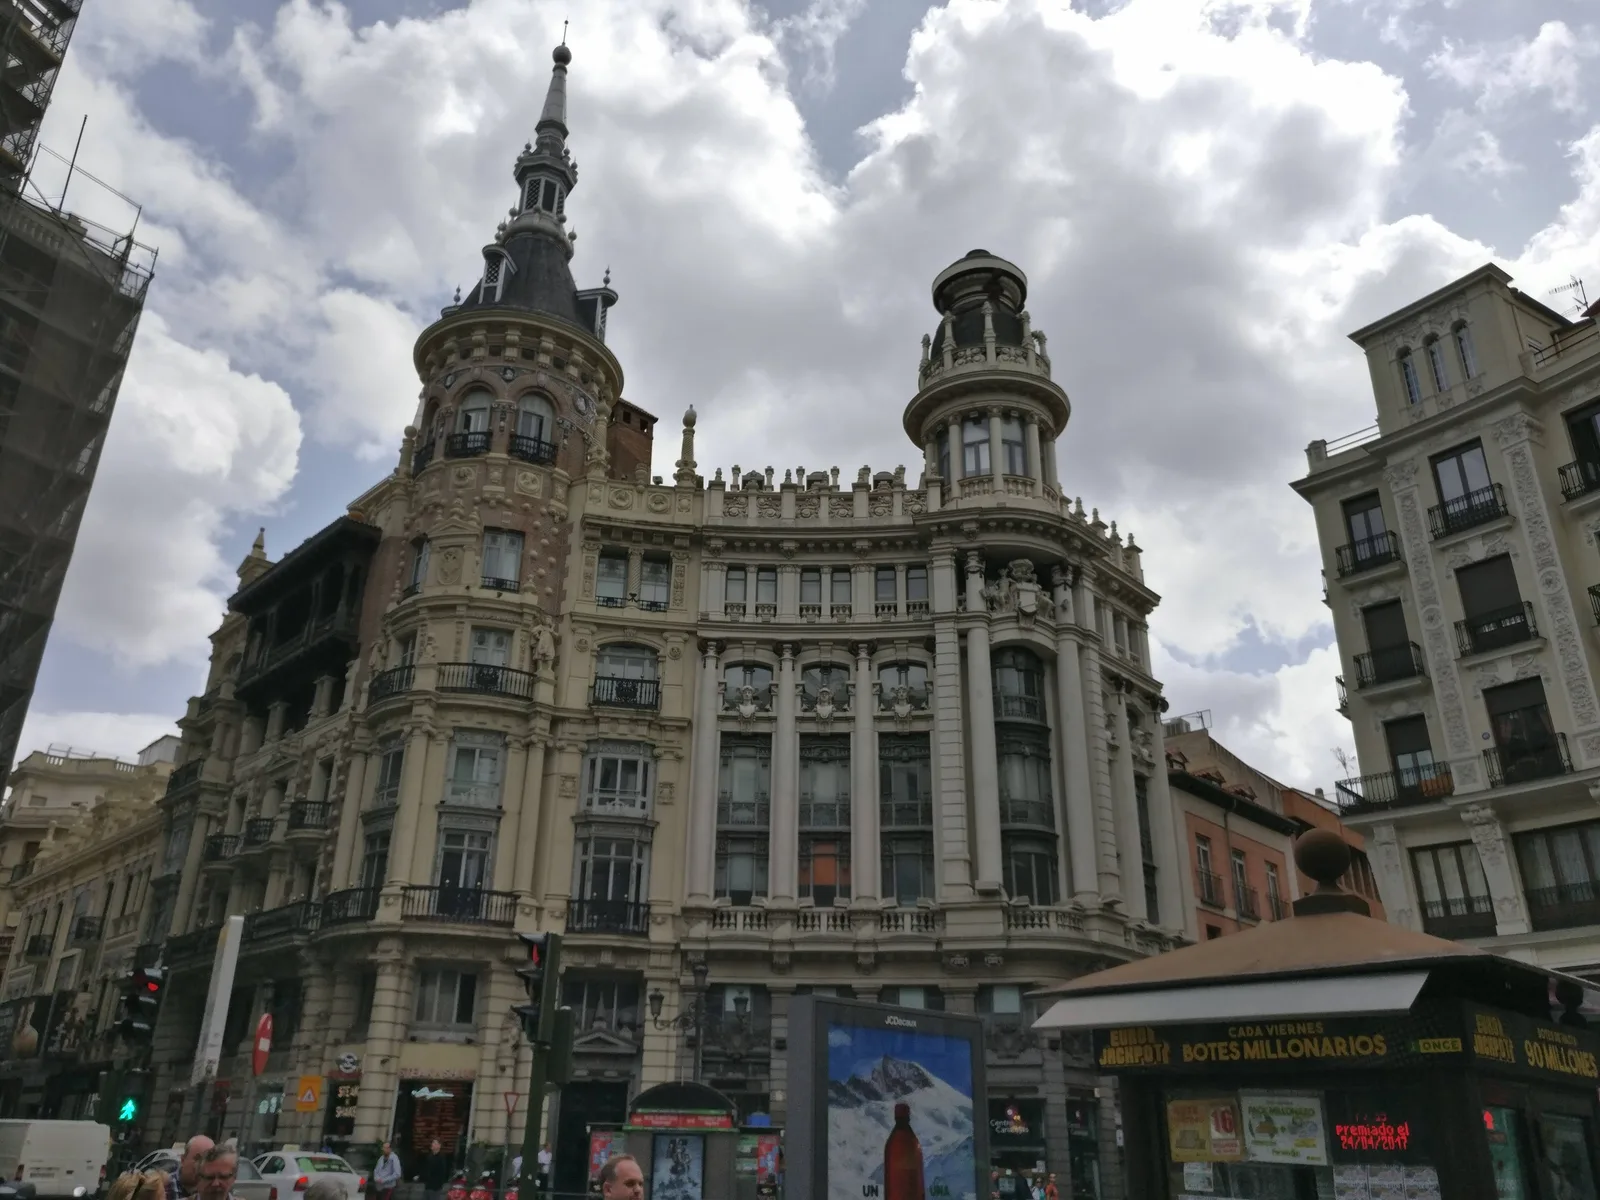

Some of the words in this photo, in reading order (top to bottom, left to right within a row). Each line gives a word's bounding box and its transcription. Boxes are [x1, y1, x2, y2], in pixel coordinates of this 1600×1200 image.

[884, 1015, 917, 1028] JCDecaux
[1228, 1026, 1262, 1038] CADA
[1264, 1021, 1325, 1036] VIERNES
[1109, 1027, 1148, 1047] EURO
[1099, 1043, 1162, 1066] JACKPOT
[1182, 1041, 1241, 1062] BOTES
[1243, 1034, 1388, 1060] MILLONARIOS
[1422, 1041, 1460, 1052] ONCE
[1525, 1040, 1544, 1068] 90
[1543, 1043, 1599, 1078] MILLONES
[1211, 1106, 1234, 1134] 16
[1396, 1120, 1410, 1136] el
[1340, 1134, 1408, 1151] 24/04/2017
[862, 1185, 879, 1197] UN
